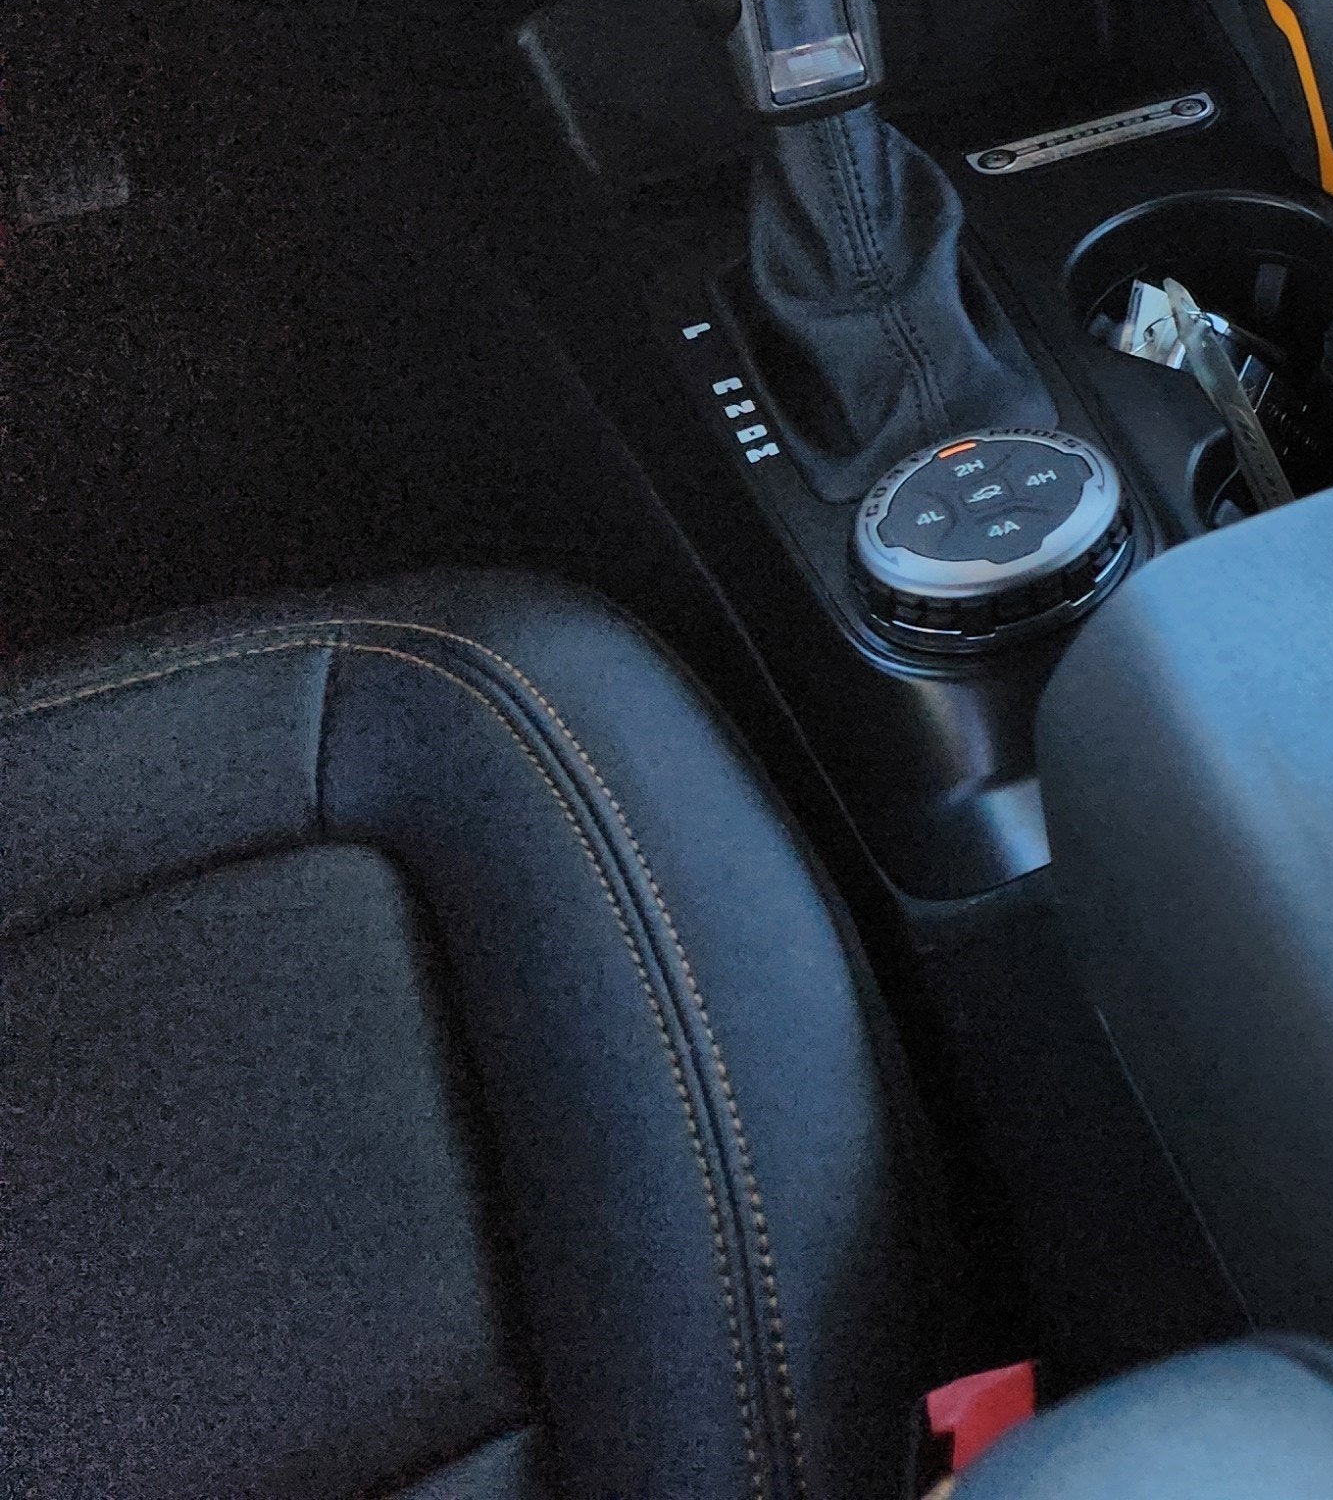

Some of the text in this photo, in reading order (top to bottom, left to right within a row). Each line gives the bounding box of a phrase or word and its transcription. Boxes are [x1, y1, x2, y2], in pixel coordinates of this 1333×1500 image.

[953, 458, 985, 479] 2H
[1025, 468, 1058, 487] 4H
[915, 510, 946, 527] 4L
[987, 519, 1021, 538] 4A
